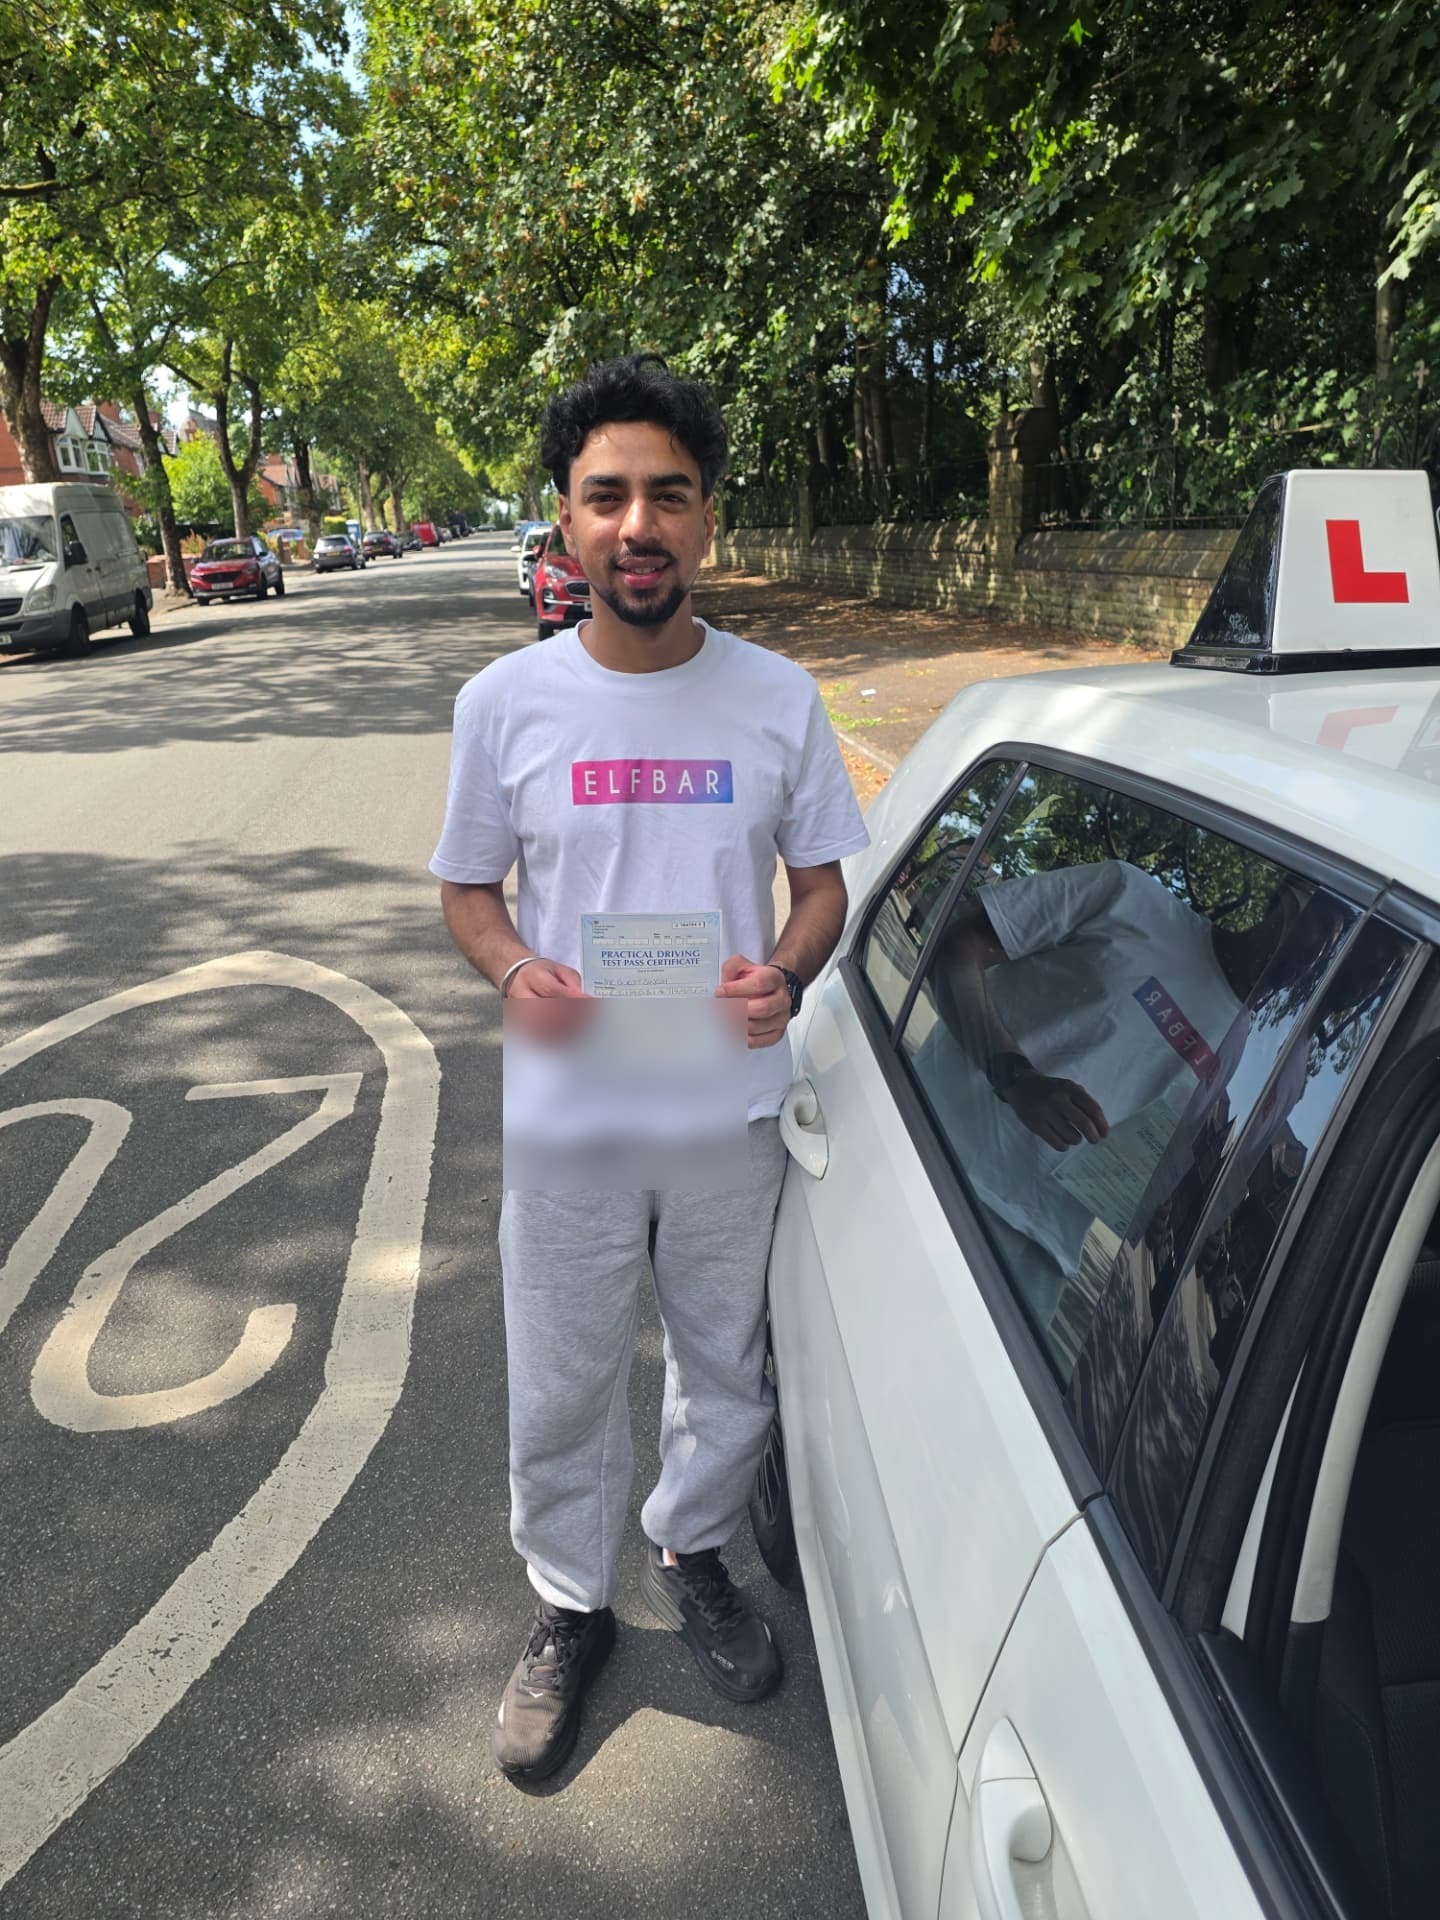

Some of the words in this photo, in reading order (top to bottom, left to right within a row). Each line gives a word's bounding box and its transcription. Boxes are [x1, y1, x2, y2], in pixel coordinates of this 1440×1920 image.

[1325, 519, 1410, 604] L
[601, 950, 653, 959] PRACTICAL
[656, 949, 701, 958] DRIVING
[602, 959, 622, 967] TEST
[624, 959, 645, 967] PASS
[646, 958, 700, 967] CERTIFICATE
